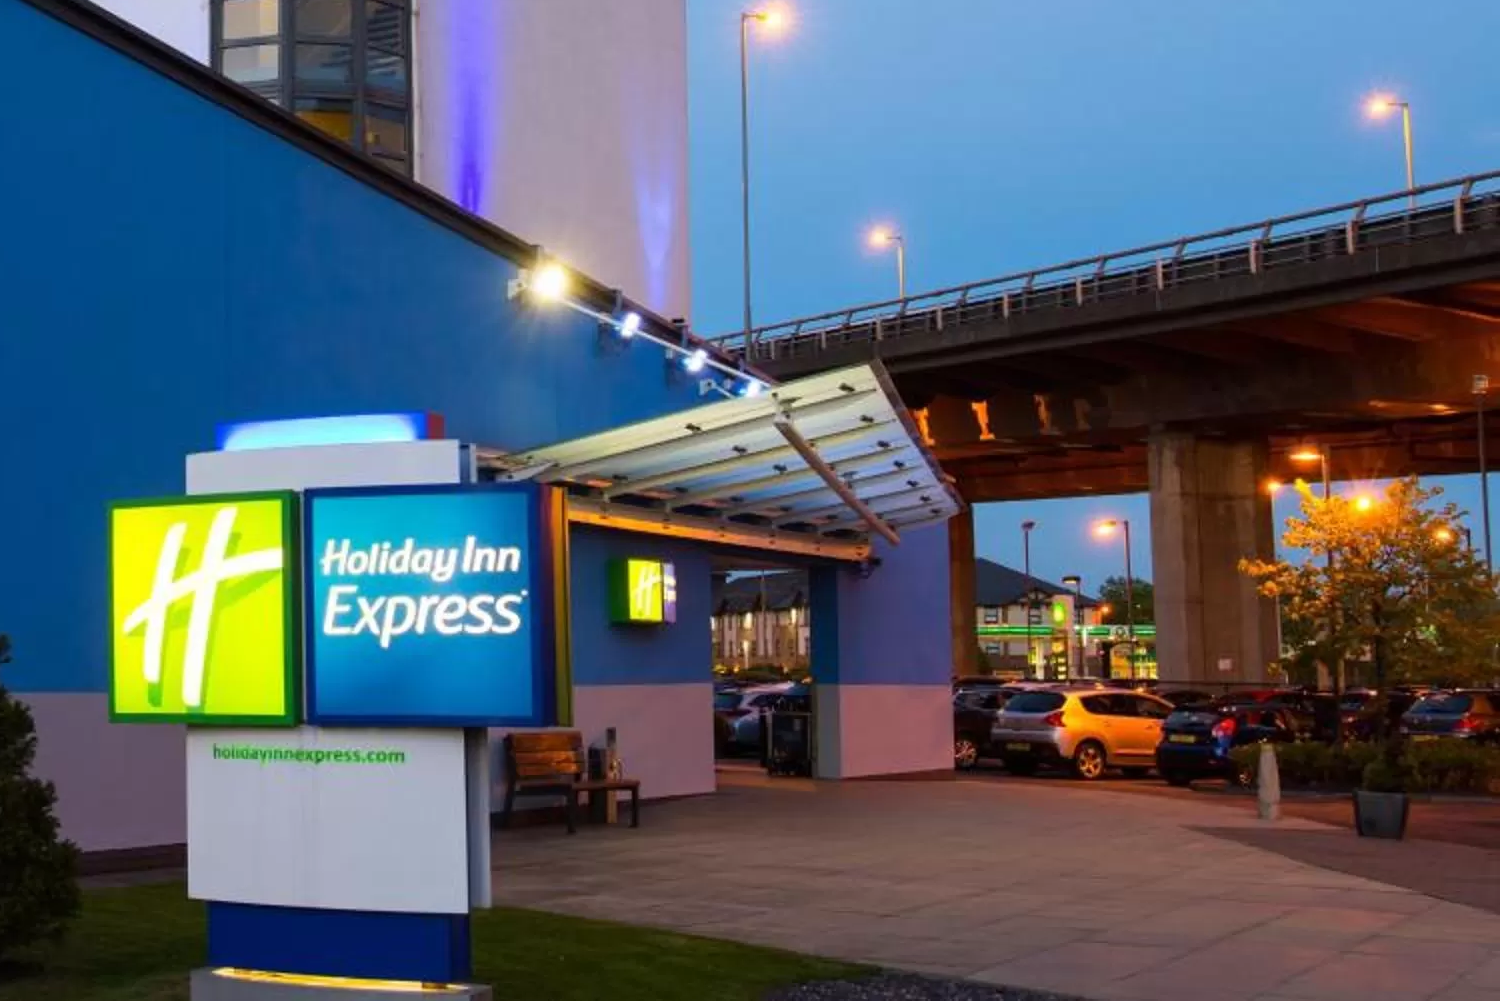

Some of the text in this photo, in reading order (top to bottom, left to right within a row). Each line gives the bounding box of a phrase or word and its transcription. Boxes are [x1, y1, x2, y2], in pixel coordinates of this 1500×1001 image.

[320, 534, 522, 583] Holiday Inn
[322, 584, 523, 649] Express
[212, 742, 405, 765] holidayinnexpress.com
